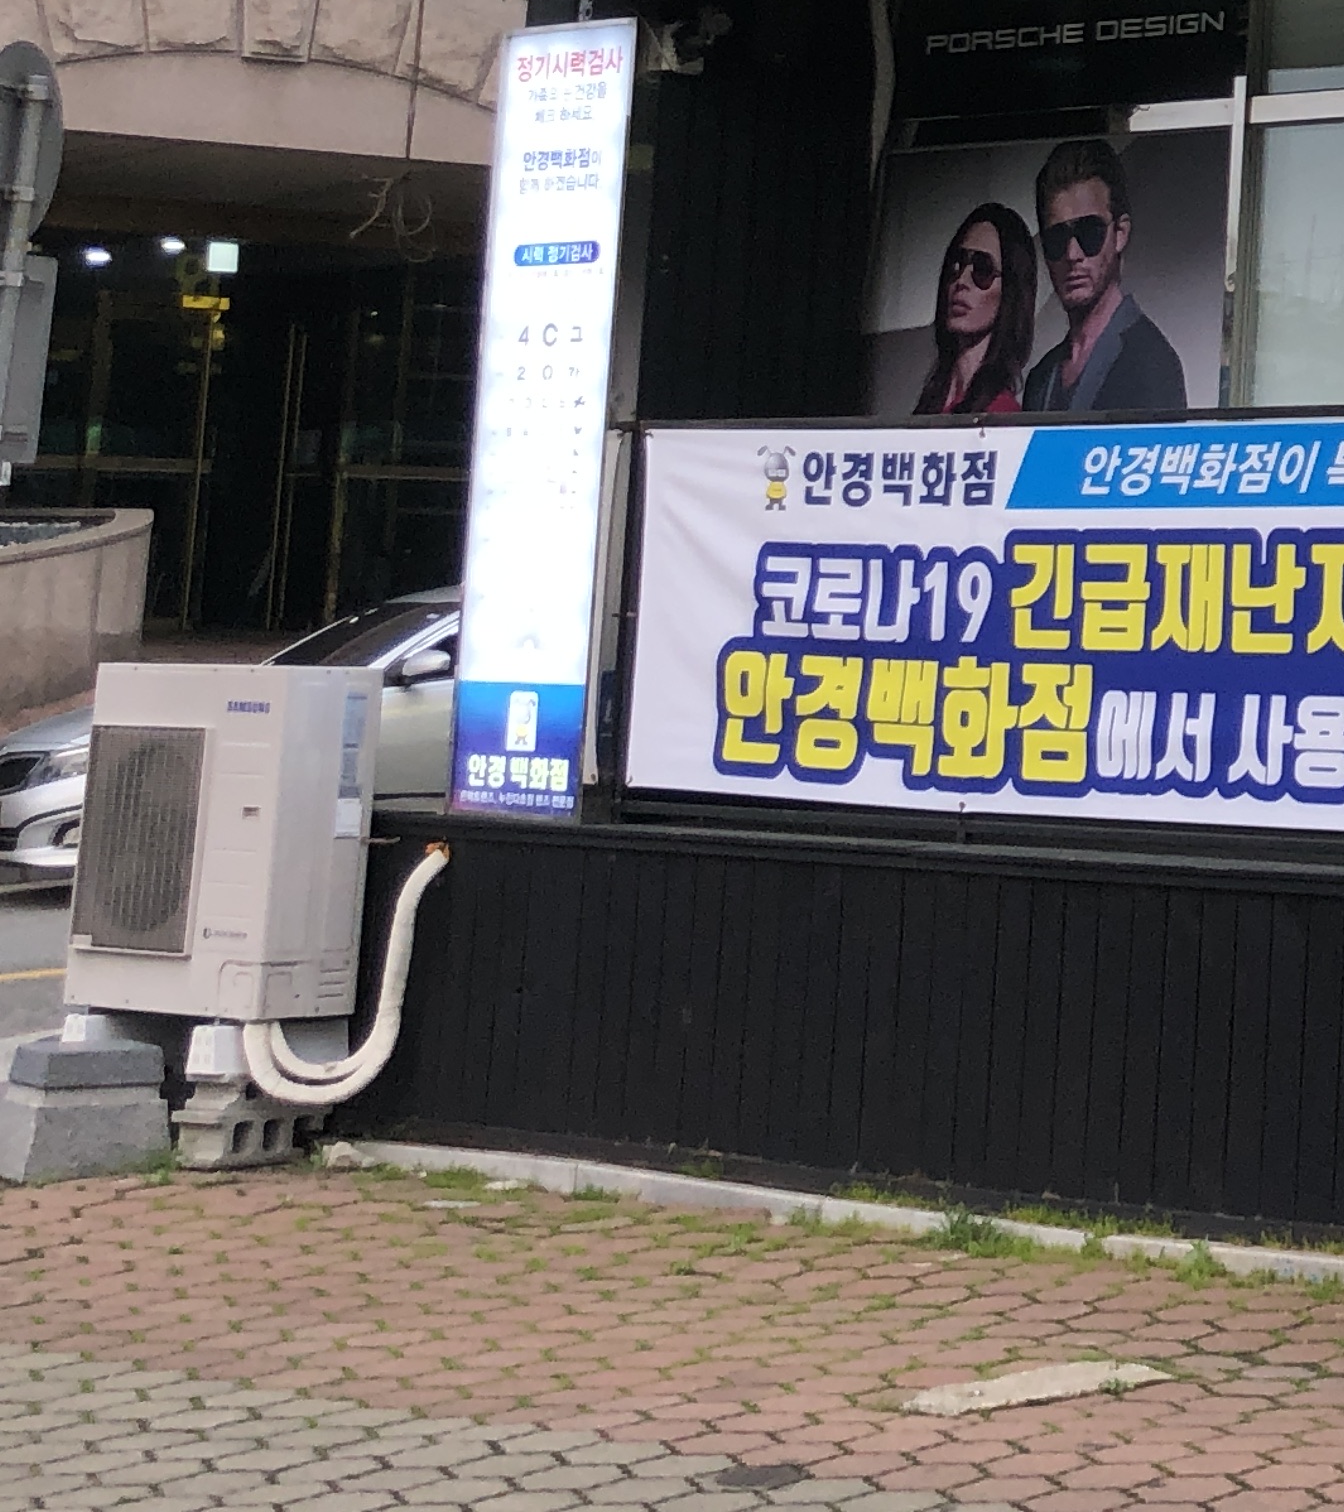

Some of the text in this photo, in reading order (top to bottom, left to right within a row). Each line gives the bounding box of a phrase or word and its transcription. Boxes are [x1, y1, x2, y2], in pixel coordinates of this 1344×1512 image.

[926, 11, 1225, 55] PORSCHE DESIGN
[517, 46, 624, 82] 정기시력검사
[802, 450, 998, 507] 안경백화점
[1080, 439, 1319, 496] 안경백화점이
[760, 555, 993, 644] 코로나19
[227, 701, 270, 714] SAMSUNG
[720, 650, 1215, 783] 안경백화점에서
